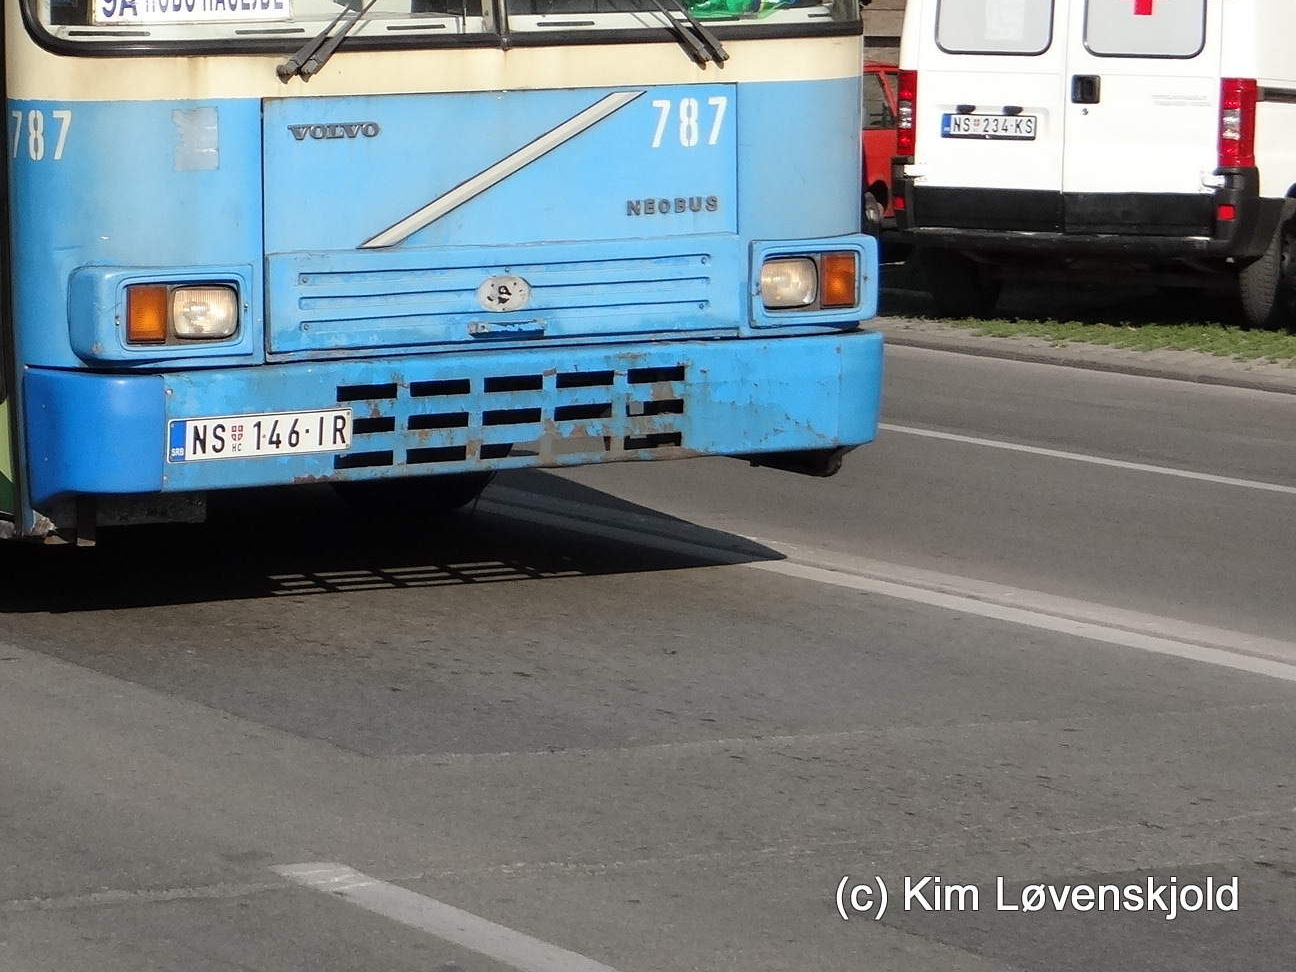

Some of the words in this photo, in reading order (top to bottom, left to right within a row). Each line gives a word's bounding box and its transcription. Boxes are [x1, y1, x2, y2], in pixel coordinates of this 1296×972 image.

[287, 121, 380, 141] VOLVO
[651, 96, 728, 149] 787
[953, 117, 971, 132] NS
[11, 109, 73, 161] 787
[626, 196, 719, 216] NEOBUS
[192, 424, 226, 455] NS
[171, 447, 185, 457] SRB
